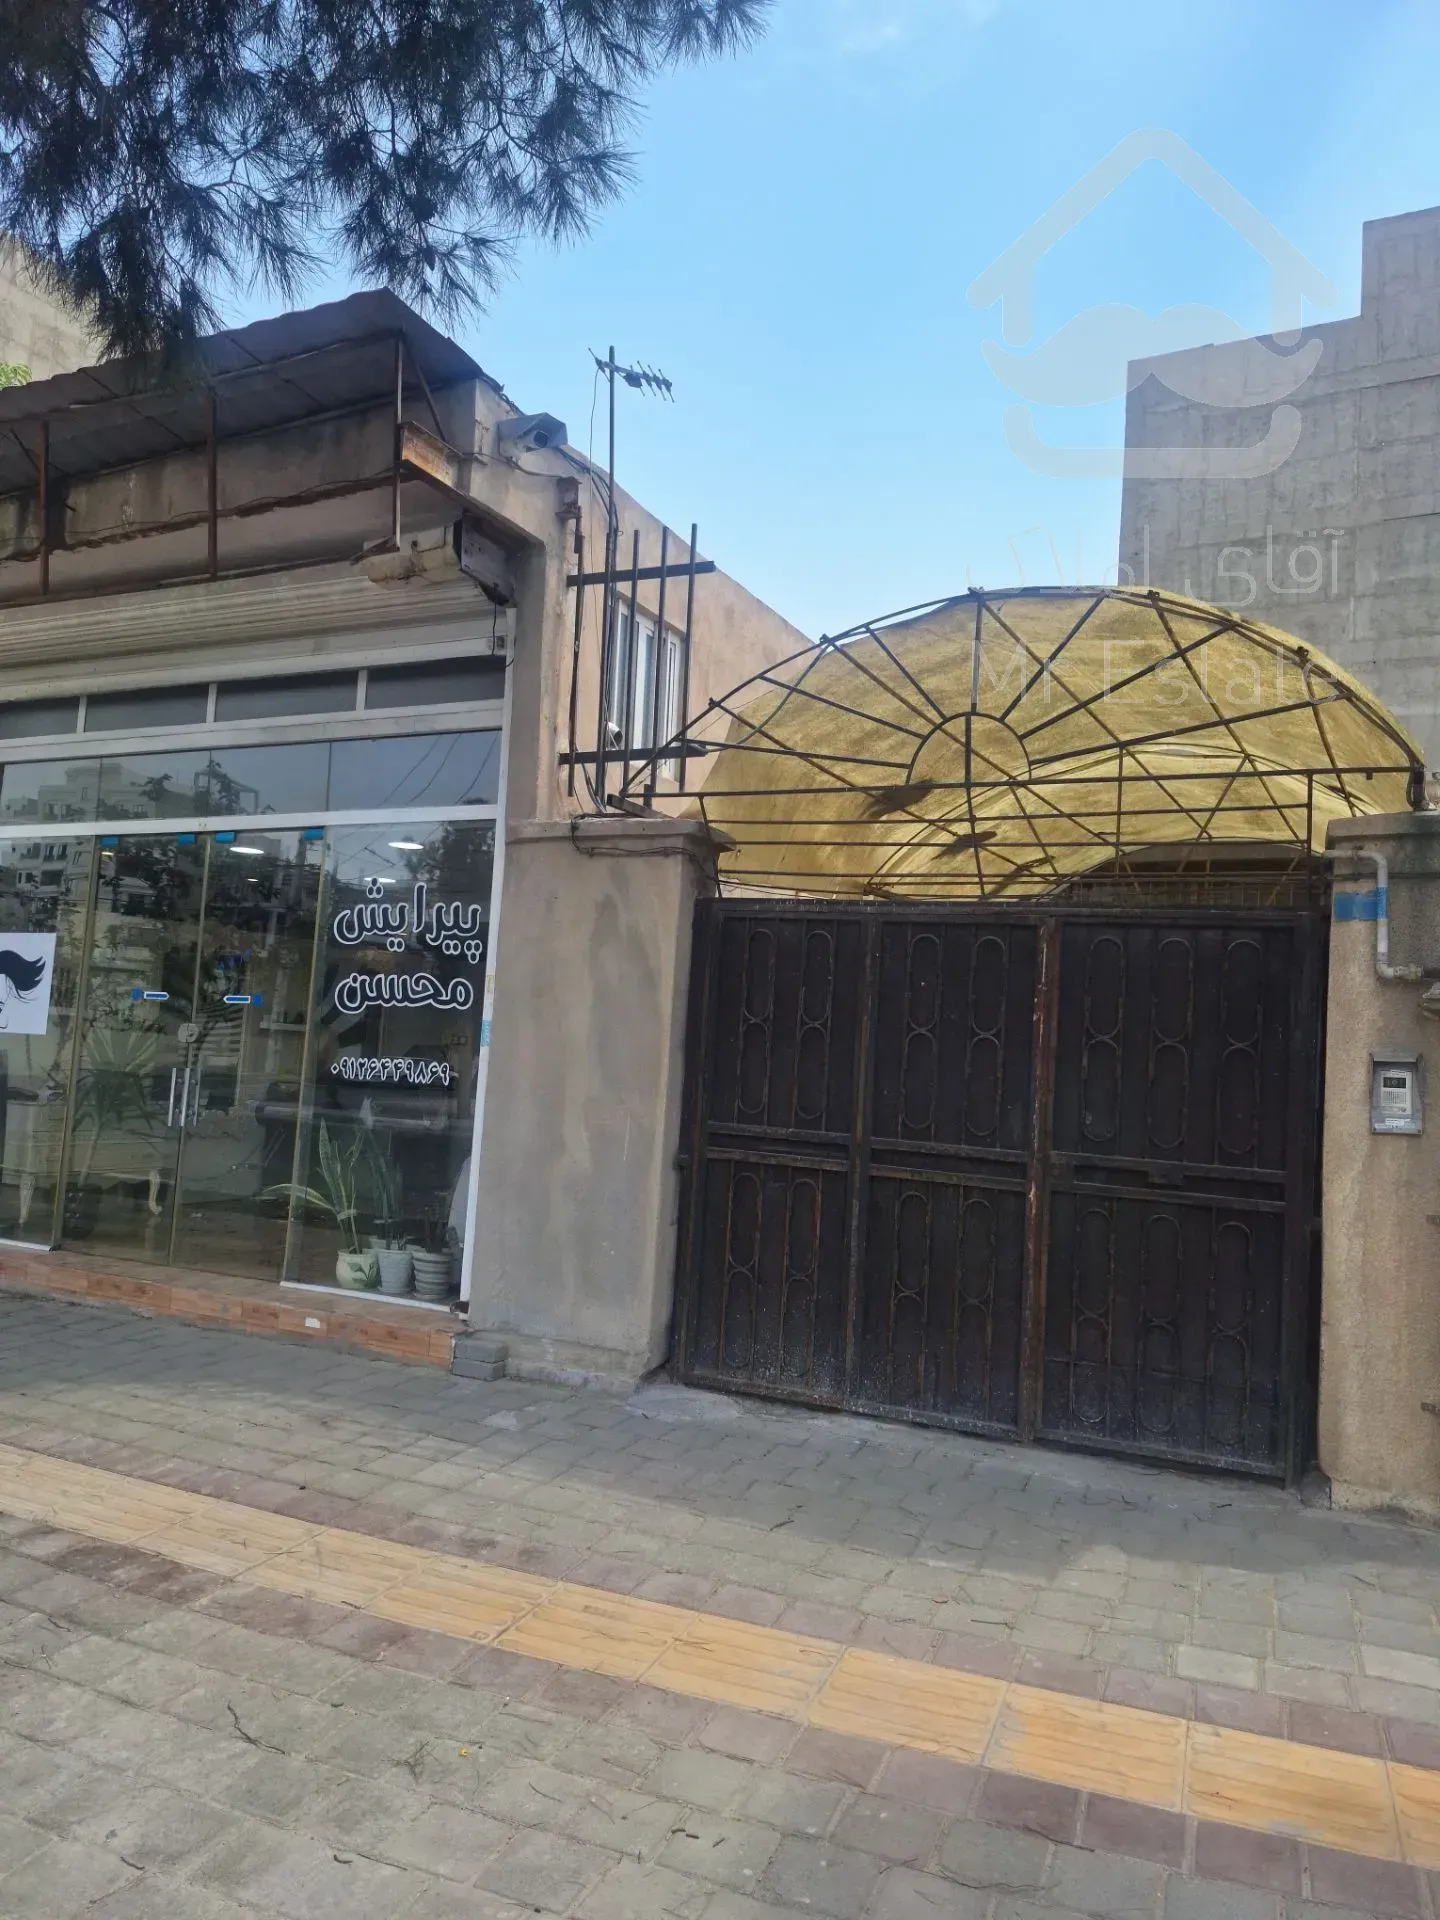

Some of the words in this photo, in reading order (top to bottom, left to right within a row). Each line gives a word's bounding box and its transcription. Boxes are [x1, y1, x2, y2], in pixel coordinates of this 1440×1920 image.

[333, 876, 483, 964] پیرایش
[334, 972, 474, 1014] محسن
[330, 1056, 450, 1086] ۰۹۱۲۶۴۴۹۸۶۹
